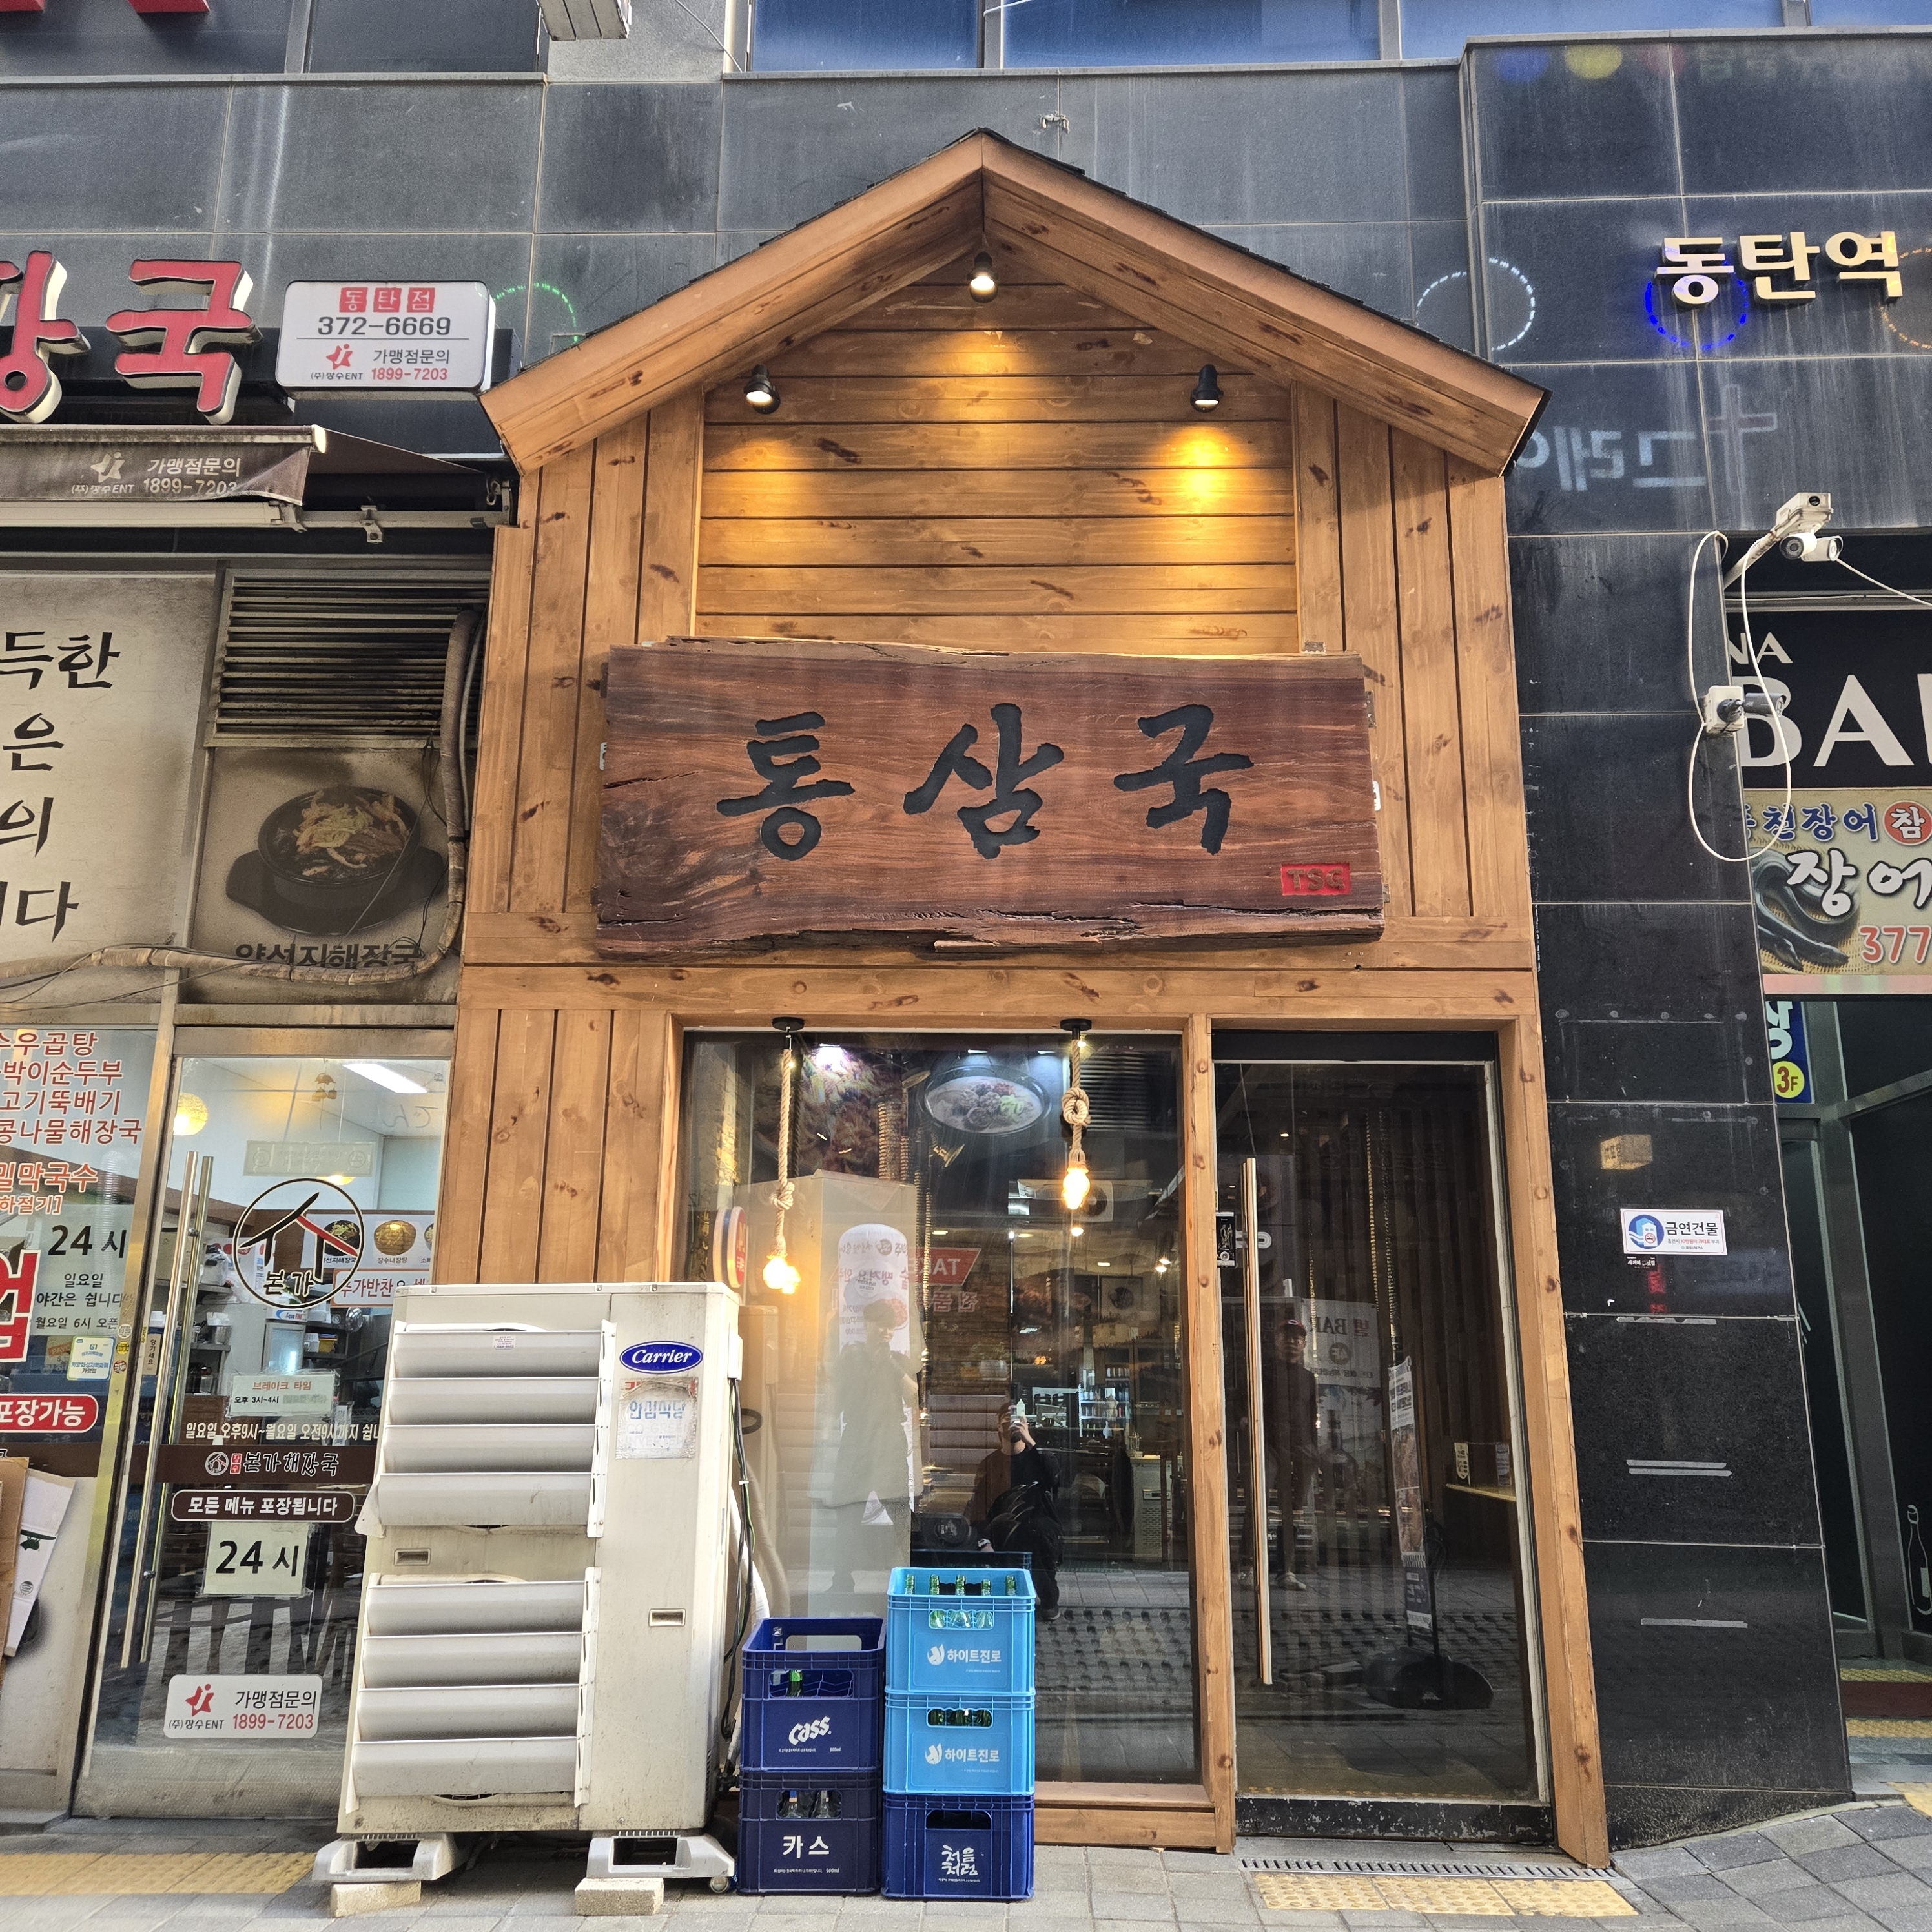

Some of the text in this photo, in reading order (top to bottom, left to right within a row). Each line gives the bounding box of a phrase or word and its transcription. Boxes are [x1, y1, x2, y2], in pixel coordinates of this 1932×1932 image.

[1654, 231, 1903, 307] 동탄역
[339, 287, 435, 313] 동탄점
[318, 316, 451, 335] 372-6669
[373, 349, 450, 365] 가맹점문의
[311, 372, 364, 380] (주)장수ENT
[371, 367, 448, 381] 1899-7203
[147, 458, 241, 477] 가맹점문의
[71, 484, 135, 495] (주)장수ENT
[0, 630, 121, 690] 득한
[1731, 673, 1932, 768] BA
[2, 712, 65, 772] 은
[716, 703, 1254, 861] 통삼국
[1744, 803, 1927, 841] 천장어 참
[1786, 848, 1932, 918] 장어
[0, 881, 80, 943] 다
[1860, 926, 1932, 963] 377
[0, 1061, 123, 1085] 박이순두부
[1776, 1066, 1799, 1093] 3F
[0, 1090, 121, 1115] 고기뚝배기
[0, 1119, 142, 1144] 콩나물해장국
[1665, 1222, 1719, 1237] 금연건물
[48, 1225, 127, 1258] 24 시
[64, 1273, 103, 1288] 일요일
[263, 1269, 314, 1297] 본가
[36, 1292, 77, 1308] 야간은
[35, 1317, 119, 1330] 월요일 6시 오픈
[147, 1339, 157, 1365] 당기세요
[632, 1349, 693, 1364] Carrier
[252, 1381, 312, 1391] 브레이크 타임
[185, 1423, 218, 1439] 일요일
[362, 1424, 380, 1441] 쉽니
[243, 1452, 339, 1476] 본가해장국
[188, 1496, 338, 1515] 모든 메뉴 포장됩니다
[214, 1540, 298, 1577] 24 시
[947, 1649, 1002, 1663] 하이트진로
[234, 1690, 316, 1711] 가맹점문의
[169, 1718, 225, 1731] (주)장수ENT
[232, 1713, 314, 1730] 1899-7203
[945, 1748, 1000, 1763] 하이트진로
[783, 1835, 830, 1859] 카스
[941, 1845, 974, 1863] 처음
[941, 1862, 978, 1876] 처럼
